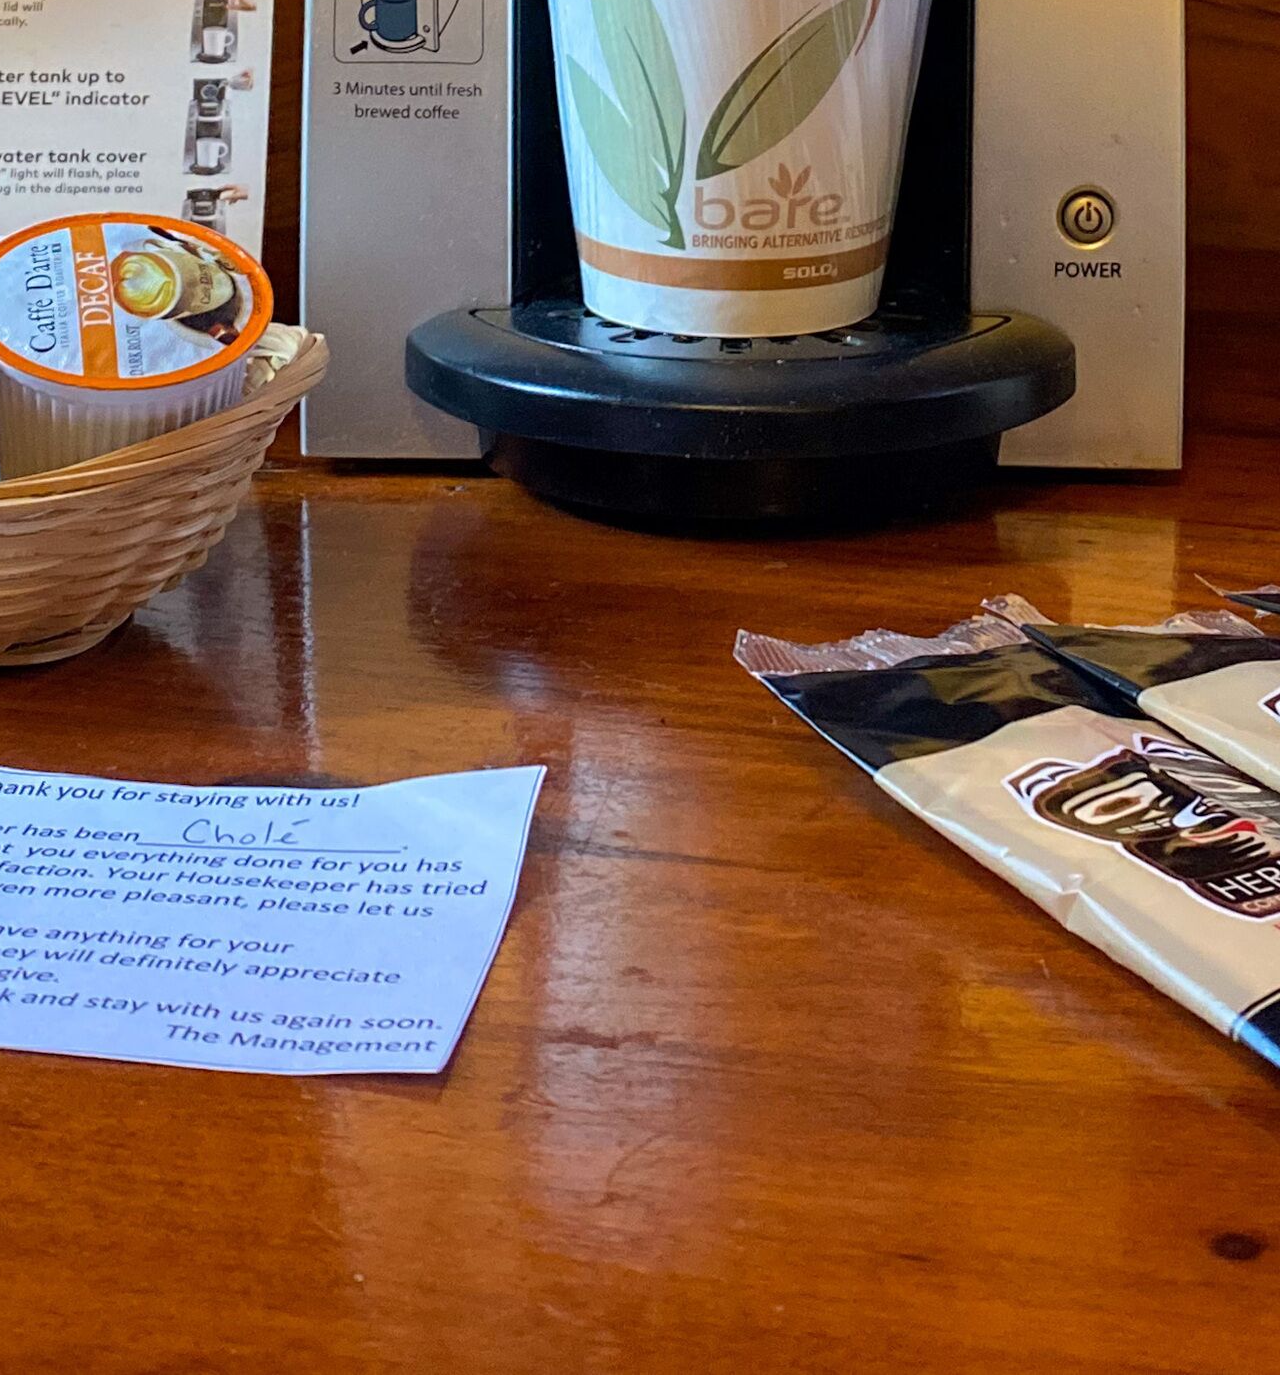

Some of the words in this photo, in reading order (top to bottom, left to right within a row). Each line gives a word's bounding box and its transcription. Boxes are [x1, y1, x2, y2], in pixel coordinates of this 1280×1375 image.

[3, 2, 18, 12] lid
[22, 2, 44, 12] will
[29, 69, 71, 84] tank
[77, 72, 100, 88] up
[105, 71, 126, 84] to
[333, 82, 341, 95] 3
[345, 82, 406, 96] Minutes
[409, 83, 442, 96] until
[446, 82, 483, 97] fresh
[65, 92, 150, 106] indicator
[354, 104, 411, 119] brewed
[414, 104, 460, 119] coffee
[49, 148, 91, 164] tank
[96, 151, 147, 164] cover
[694, 186, 844, 231] bare
[692, 234, 758, 249] BRINGING
[762, 228, 841, 249] ALTERNATIVE
[783, 264, 833, 280] SOLO
[74, 251, 112, 328] DECAF
[29, 298, 56, 354] Caffé
[58, 785, 104, 804] you
[110, 785, 151, 802] for
[155, 791, 249, 810] staying
[255, 793, 312, 809] with
[321, 793, 360, 809] us!
[21, 822, 67, 840] has
[74, 826, 139, 843] been
[26, 843, 75, 867] you
[82, 847, 225, 869] everything
[234, 854, 303, 871] done
[311, 856, 353, 872] for
[359, 859, 407, 875] you
[416, 858, 463, 874] has
[106, 866, 169, 884] Your
[174, 871, 360, 897] Housekeeper
[365, 878, 413, 897] has
[420, 879, 488, 897] tried
[42, 883, 116, 901] more
[122, 886, 249, 910] pleasant,
[257, 896, 351, 916] please
[357, 900, 394, 919] let
[402, 904, 434, 919] us
[45, 925, 169, 950] anything
[177, 932, 223, 950] for
[228, 940, 295, 958] your
[43, 945, 93, 963] will
[99, 949, 238, 977] definitely
[243, 960, 401, 987] appreciate
[21, 986, 74, 1008] and
[82, 994, 150, 1016] stay
[155, 998, 221, 1020] with
[230, 1008, 264, 1024] us
[270, 1011, 353, 1031] again
[359, 1016, 444, 1031] soon.
[165, 1025, 221, 1044] The
[229, 1029, 437, 1055] Management
